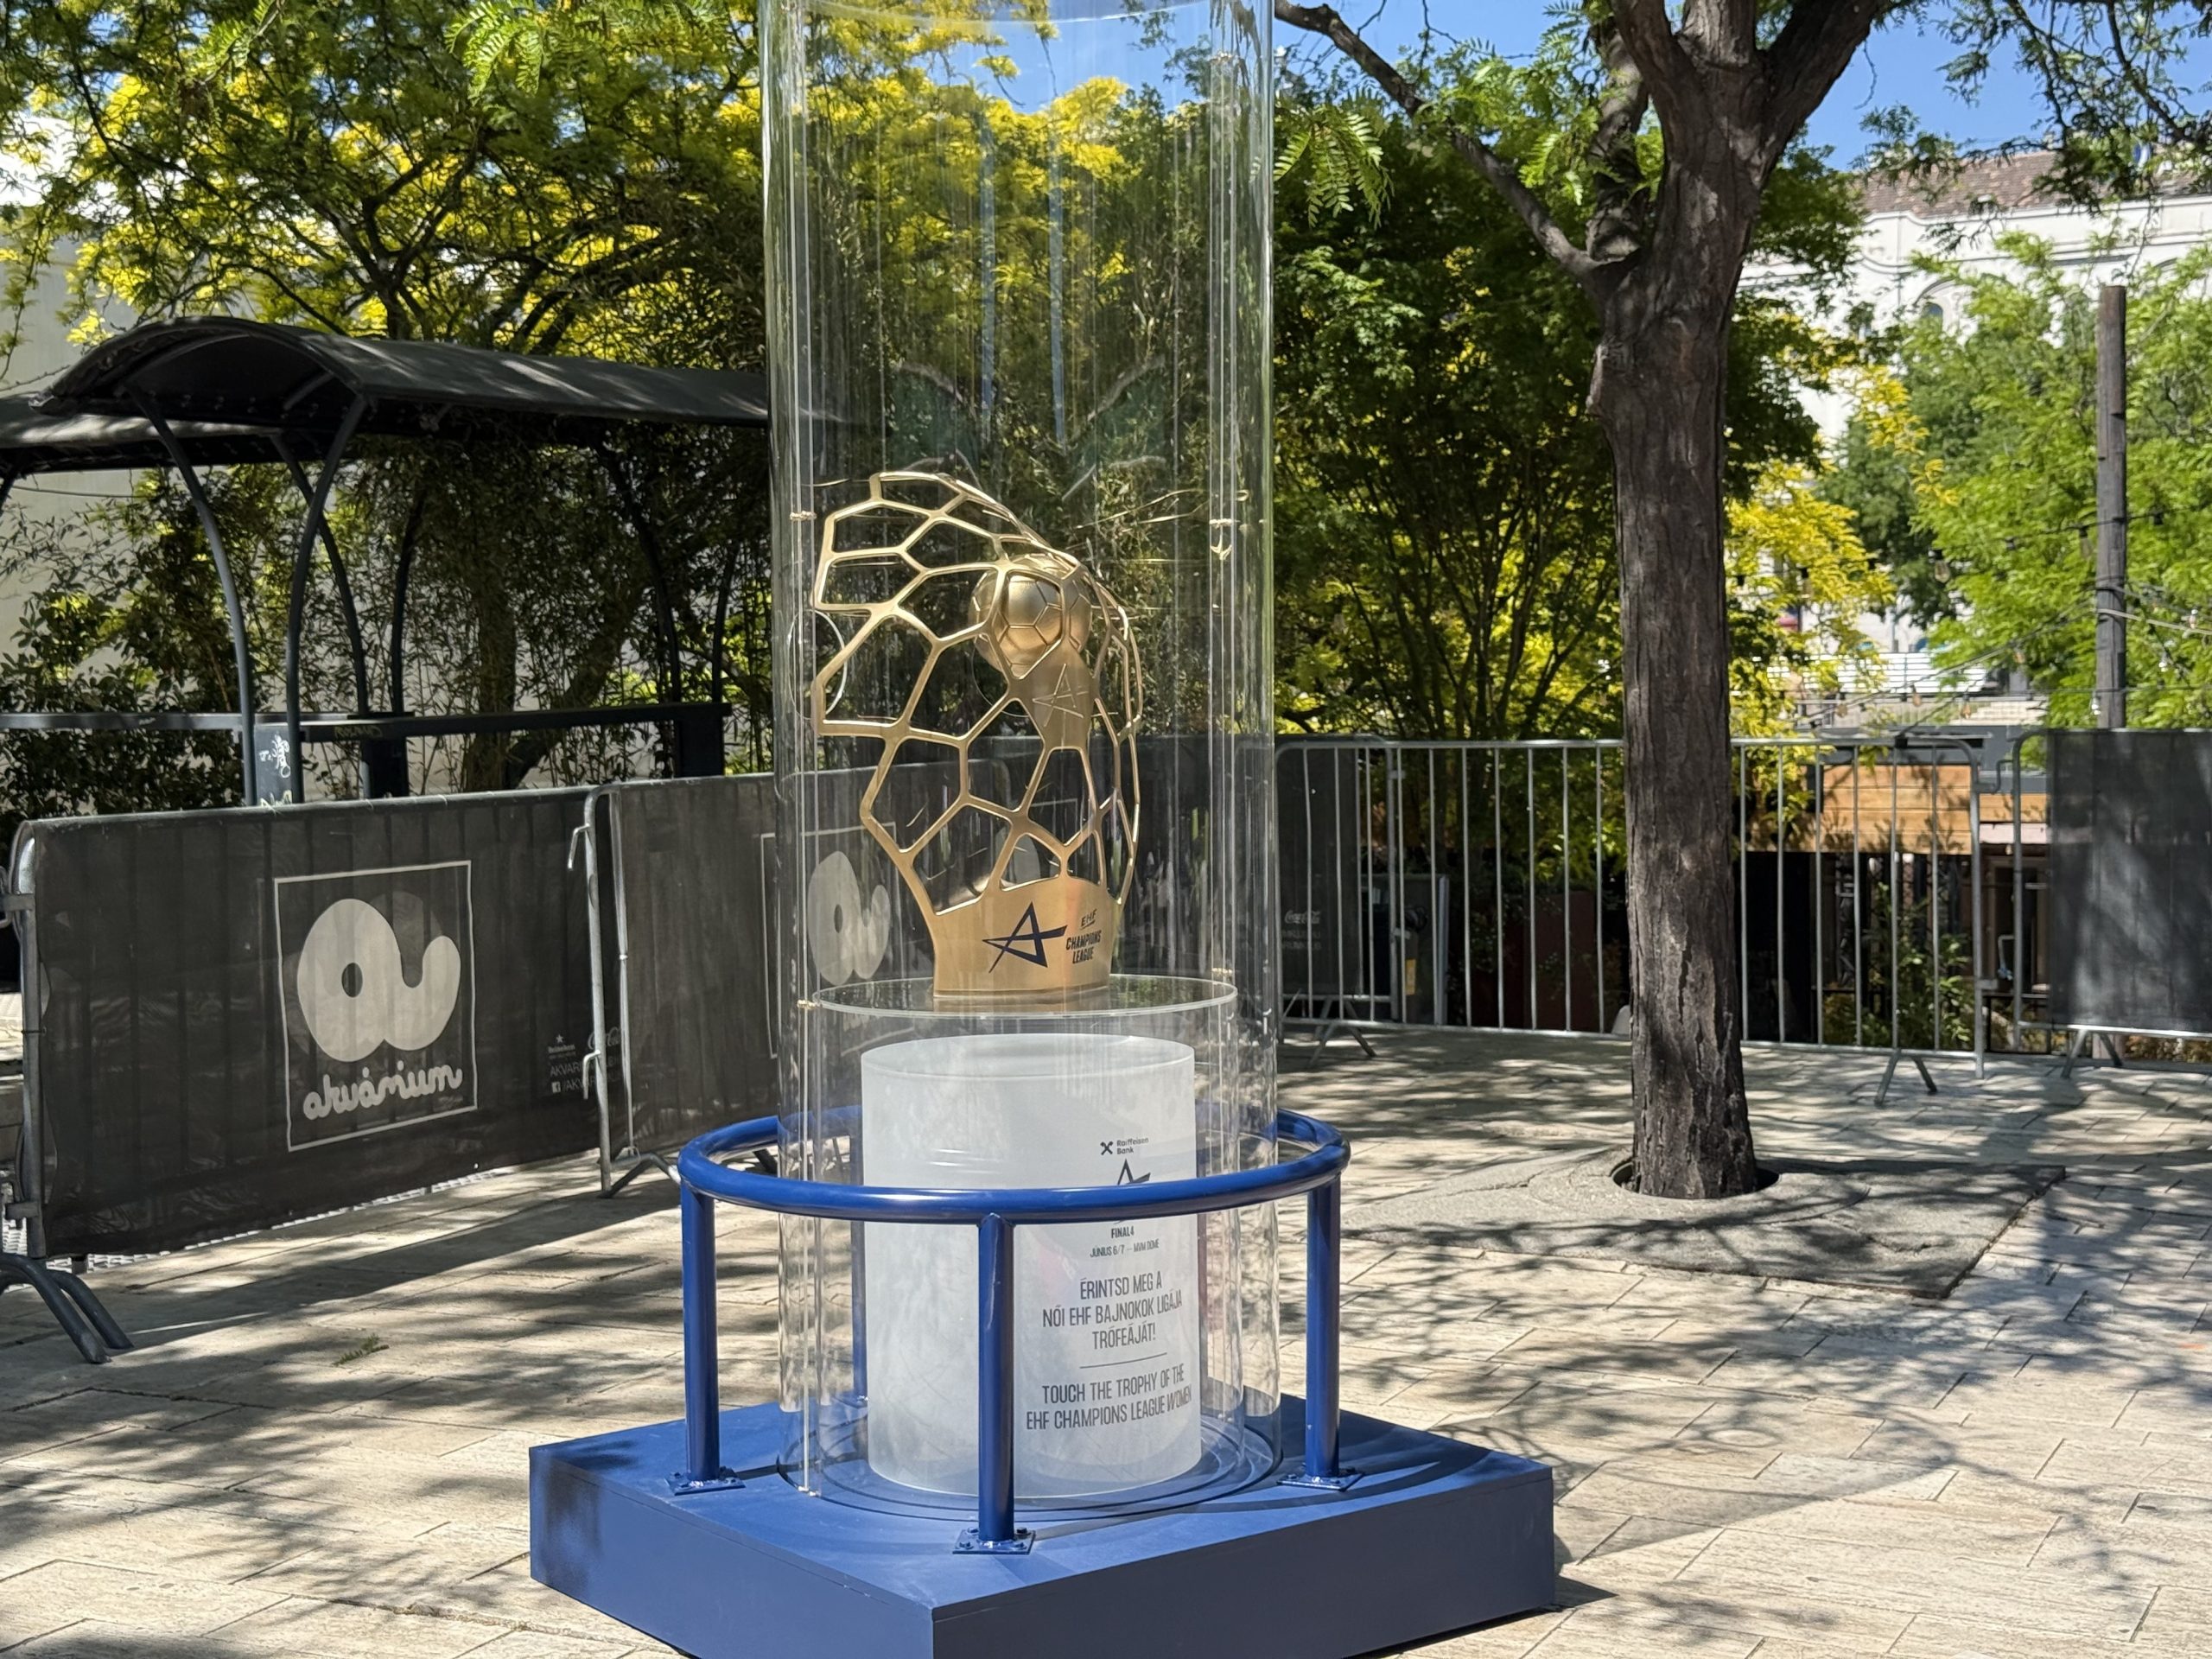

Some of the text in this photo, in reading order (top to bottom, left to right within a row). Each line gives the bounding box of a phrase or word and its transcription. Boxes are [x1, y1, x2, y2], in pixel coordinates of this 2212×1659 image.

[1081, 908, 1097, 927] EHF
[1065, 930, 1102, 950] CHAMPIONS
[1072, 946, 1094, 964] LEAGUE
[1116, 1137, 1149, 1147] Raiffeisen
[1116, 1147, 1135, 1155] Bank
[1080, 1270, 1162, 1300] ÉRINTSD MEG A
[1042, 1288, 1183, 1327] NŐI EHF BAJNOKOK LIGÁJA
[1092, 1320, 1156, 1350] TRÓFEÁJÁT!
[1042, 1363, 1184, 1404] TOUCH THE TROPHY OF THE
[1027, 1384, 1192, 1430] EHF CHAMPIONS LEAGUE WOMEN
